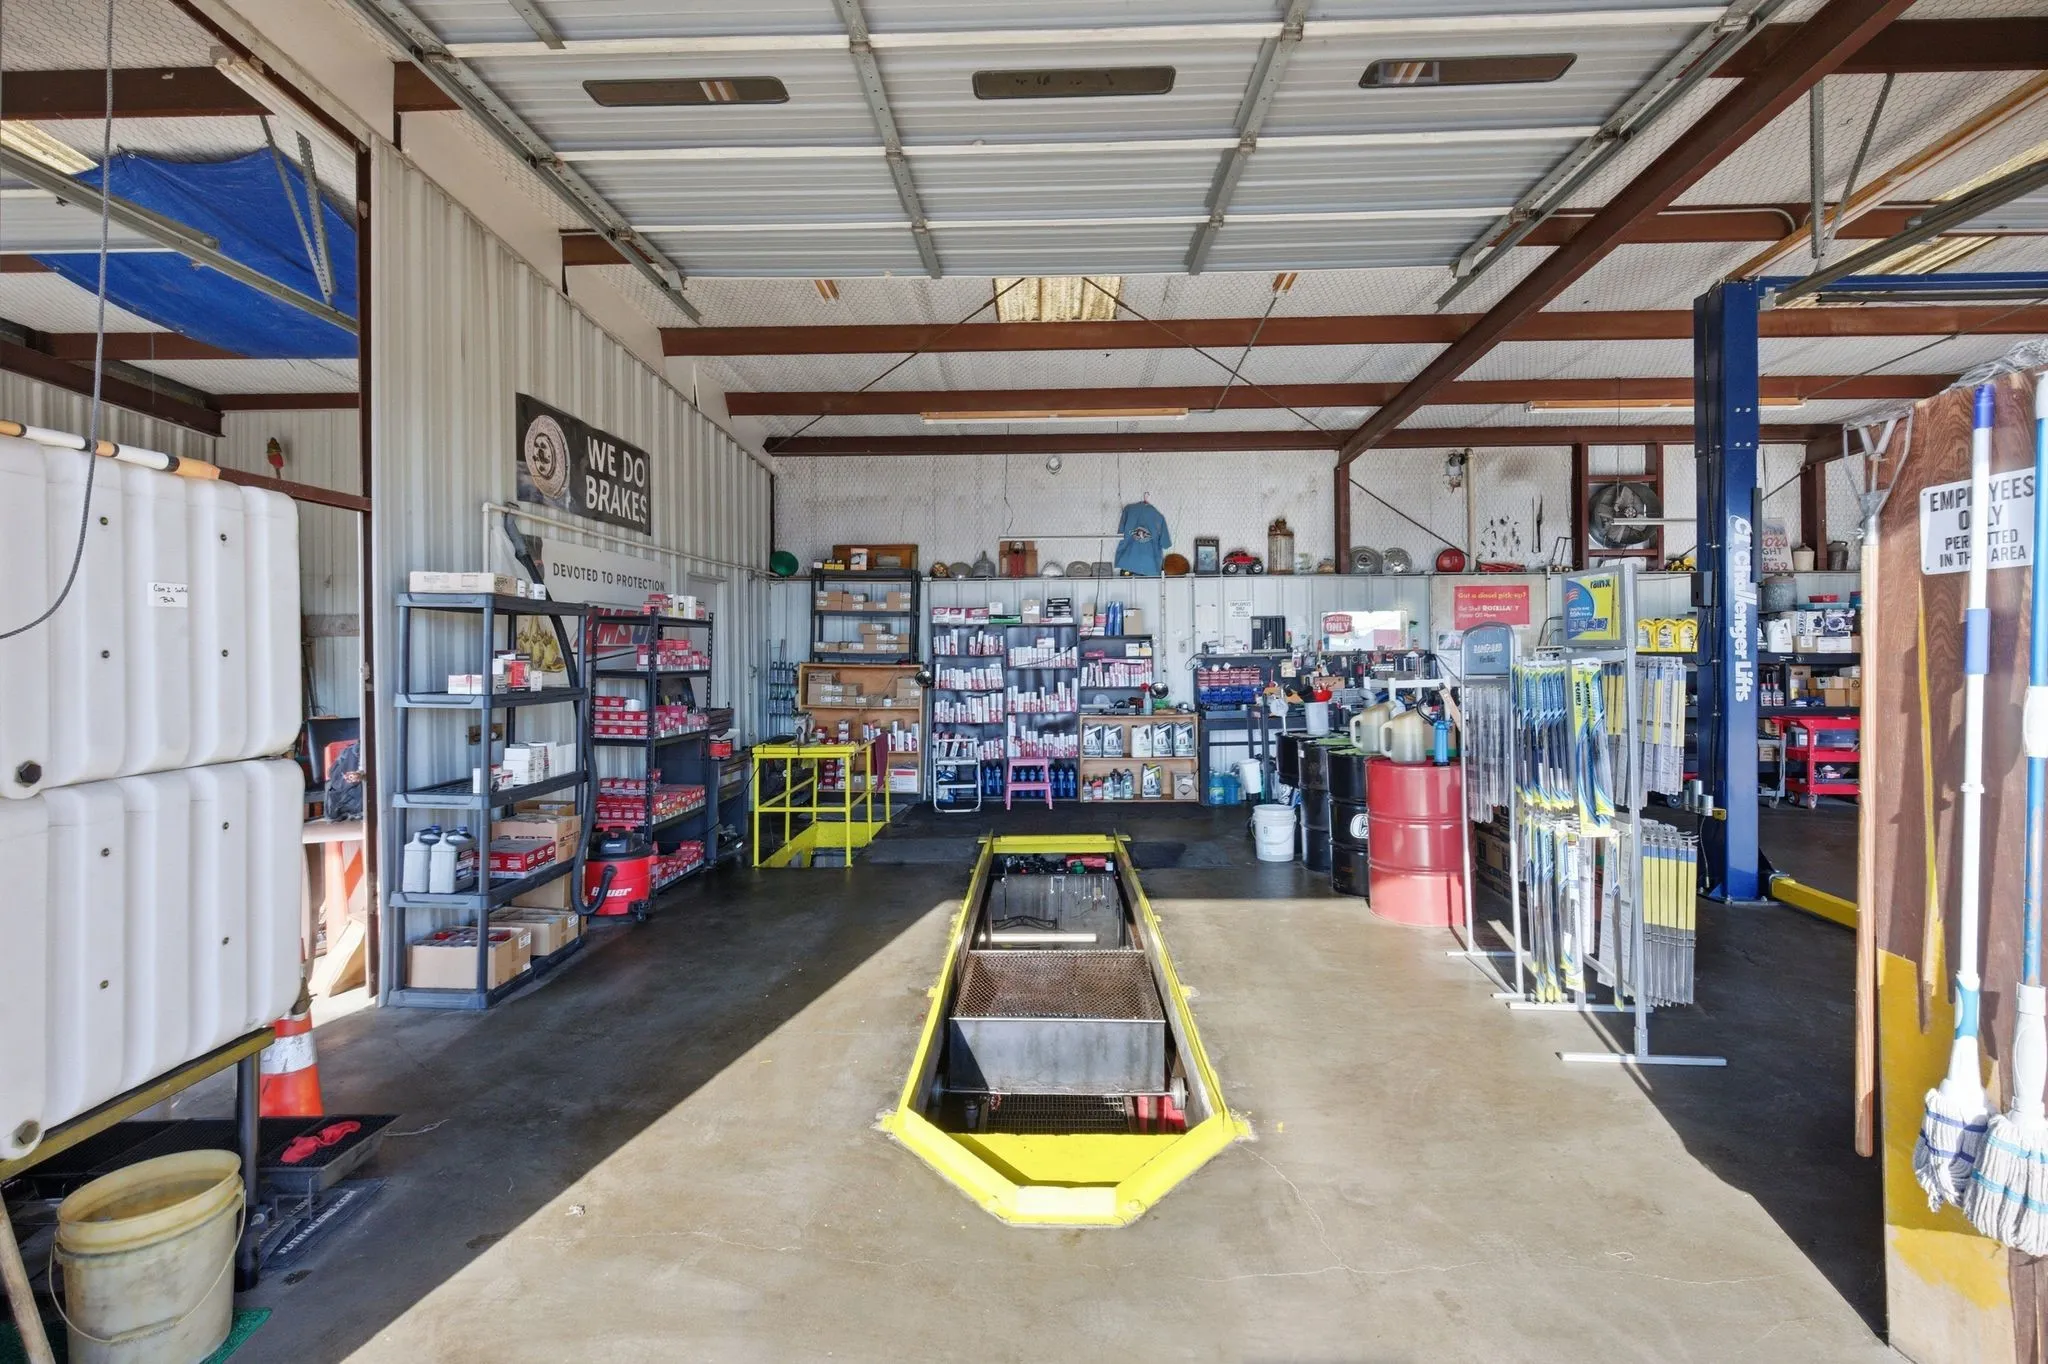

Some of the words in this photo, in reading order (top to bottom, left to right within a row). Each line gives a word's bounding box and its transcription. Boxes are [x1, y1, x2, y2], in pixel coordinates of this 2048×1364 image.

[587, 435, 617, 477] WE
[623, 450, 645, 488] DO
[585, 474, 647, 525] BRAKES
[1929, 475, 2034, 513] EMPYEES
[1958, 504, 2004, 531] OY
[1945, 528, 2019, 551] PERTTED
[1940, 553, 1953, 568] IN
[1990, 545, 2027, 562] AREA
[553, 562, 598, 583] DEVOTED
[602, 570, 614, 585] TO
[616, 573, 666, 592] PROTECTION
[1325, 622, 1350, 632] ONLY
[1735, 661, 1755, 702] Lifts
[591, 886, 632, 898] Buer
